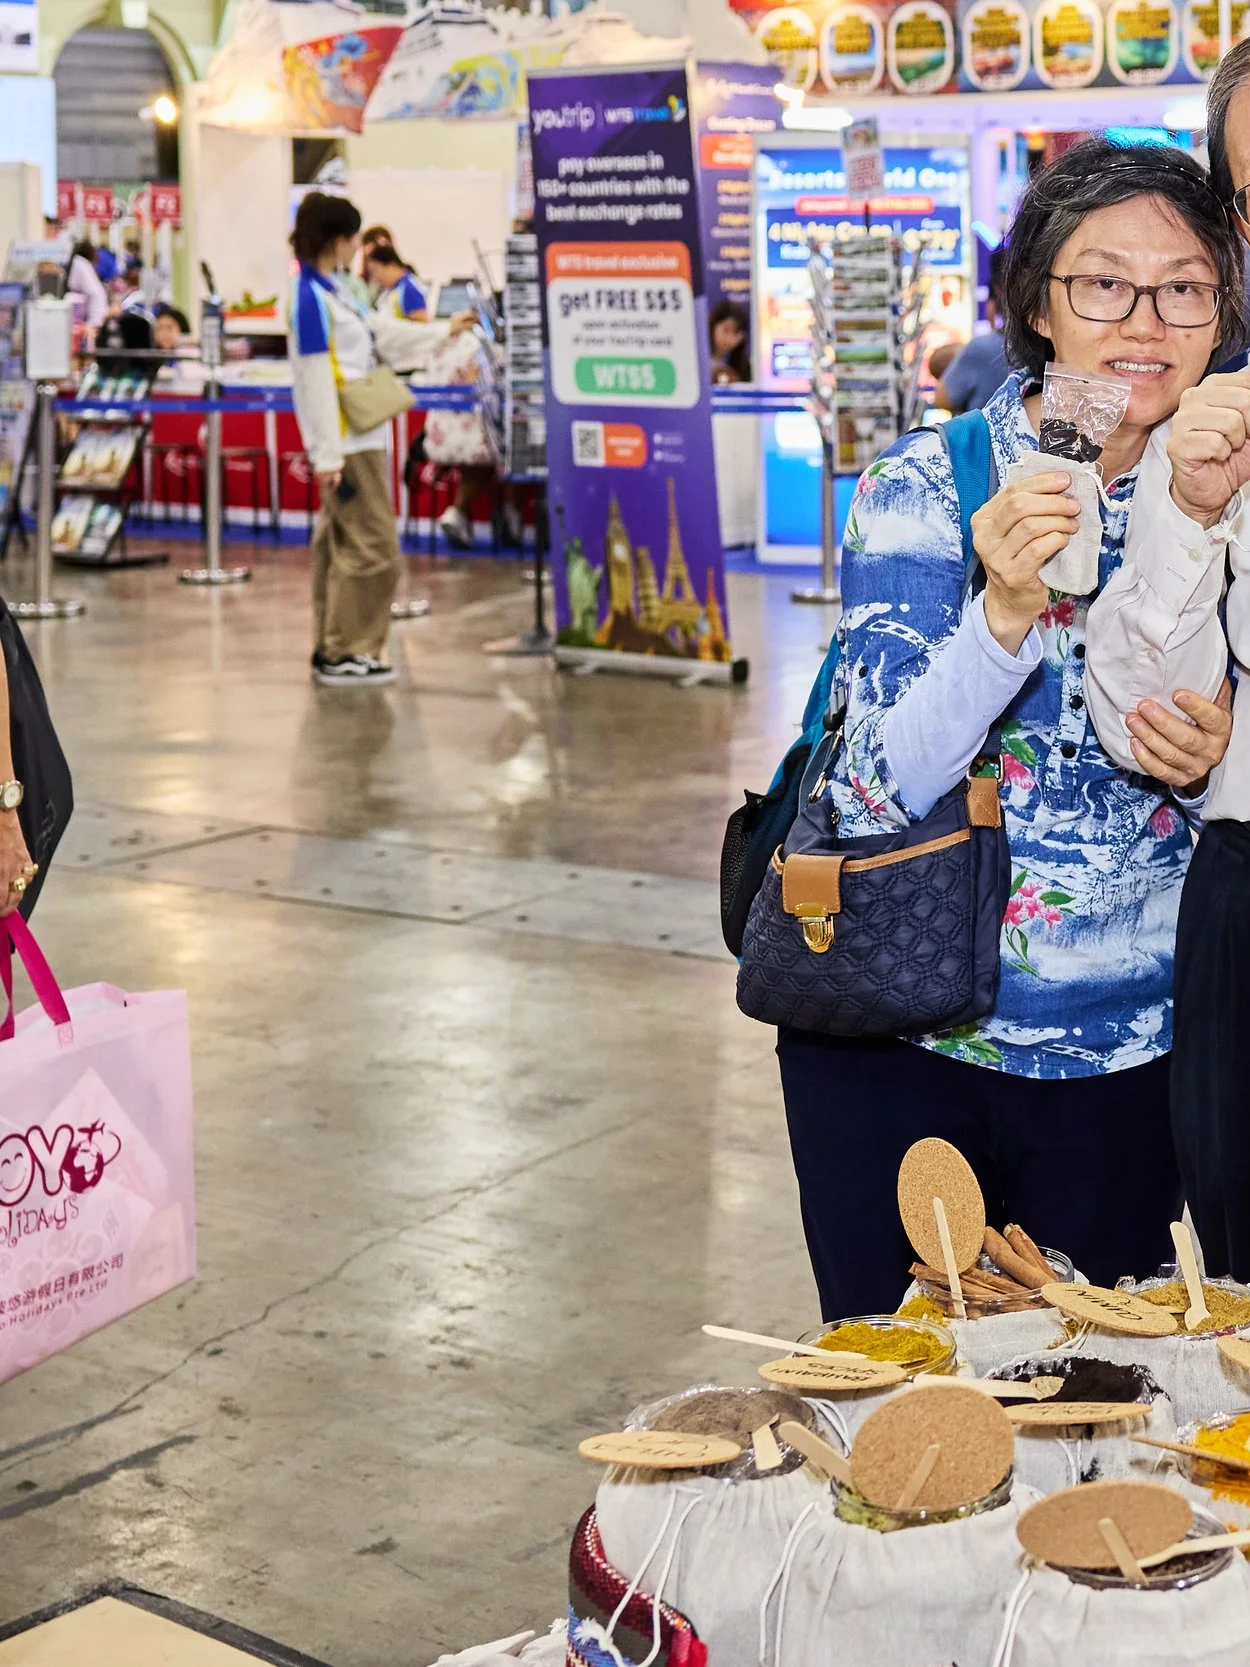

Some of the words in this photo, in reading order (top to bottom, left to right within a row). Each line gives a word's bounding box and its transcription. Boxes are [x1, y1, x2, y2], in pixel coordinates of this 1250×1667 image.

[532, 103, 595, 135] youtrip
[558, 157, 584, 177] pay
[585, 155, 646, 172] overseas
[647, 151, 664, 170] in
[537, 179, 567, 197] 150+
[568, 177, 633, 197] countries
[634, 176, 663, 195] with
[664, 176, 690, 195] the
[546, 203, 576, 222] best
[577, 202, 644, 225] exchange
[645, 203, 683, 220] rates
[557, 255, 582, 269] WTS
[585, 255, 618, 269] travel
[621, 254, 679, 269] exclusive
[559, 289, 590, 317] get
[595, 289, 638, 312] FREE
